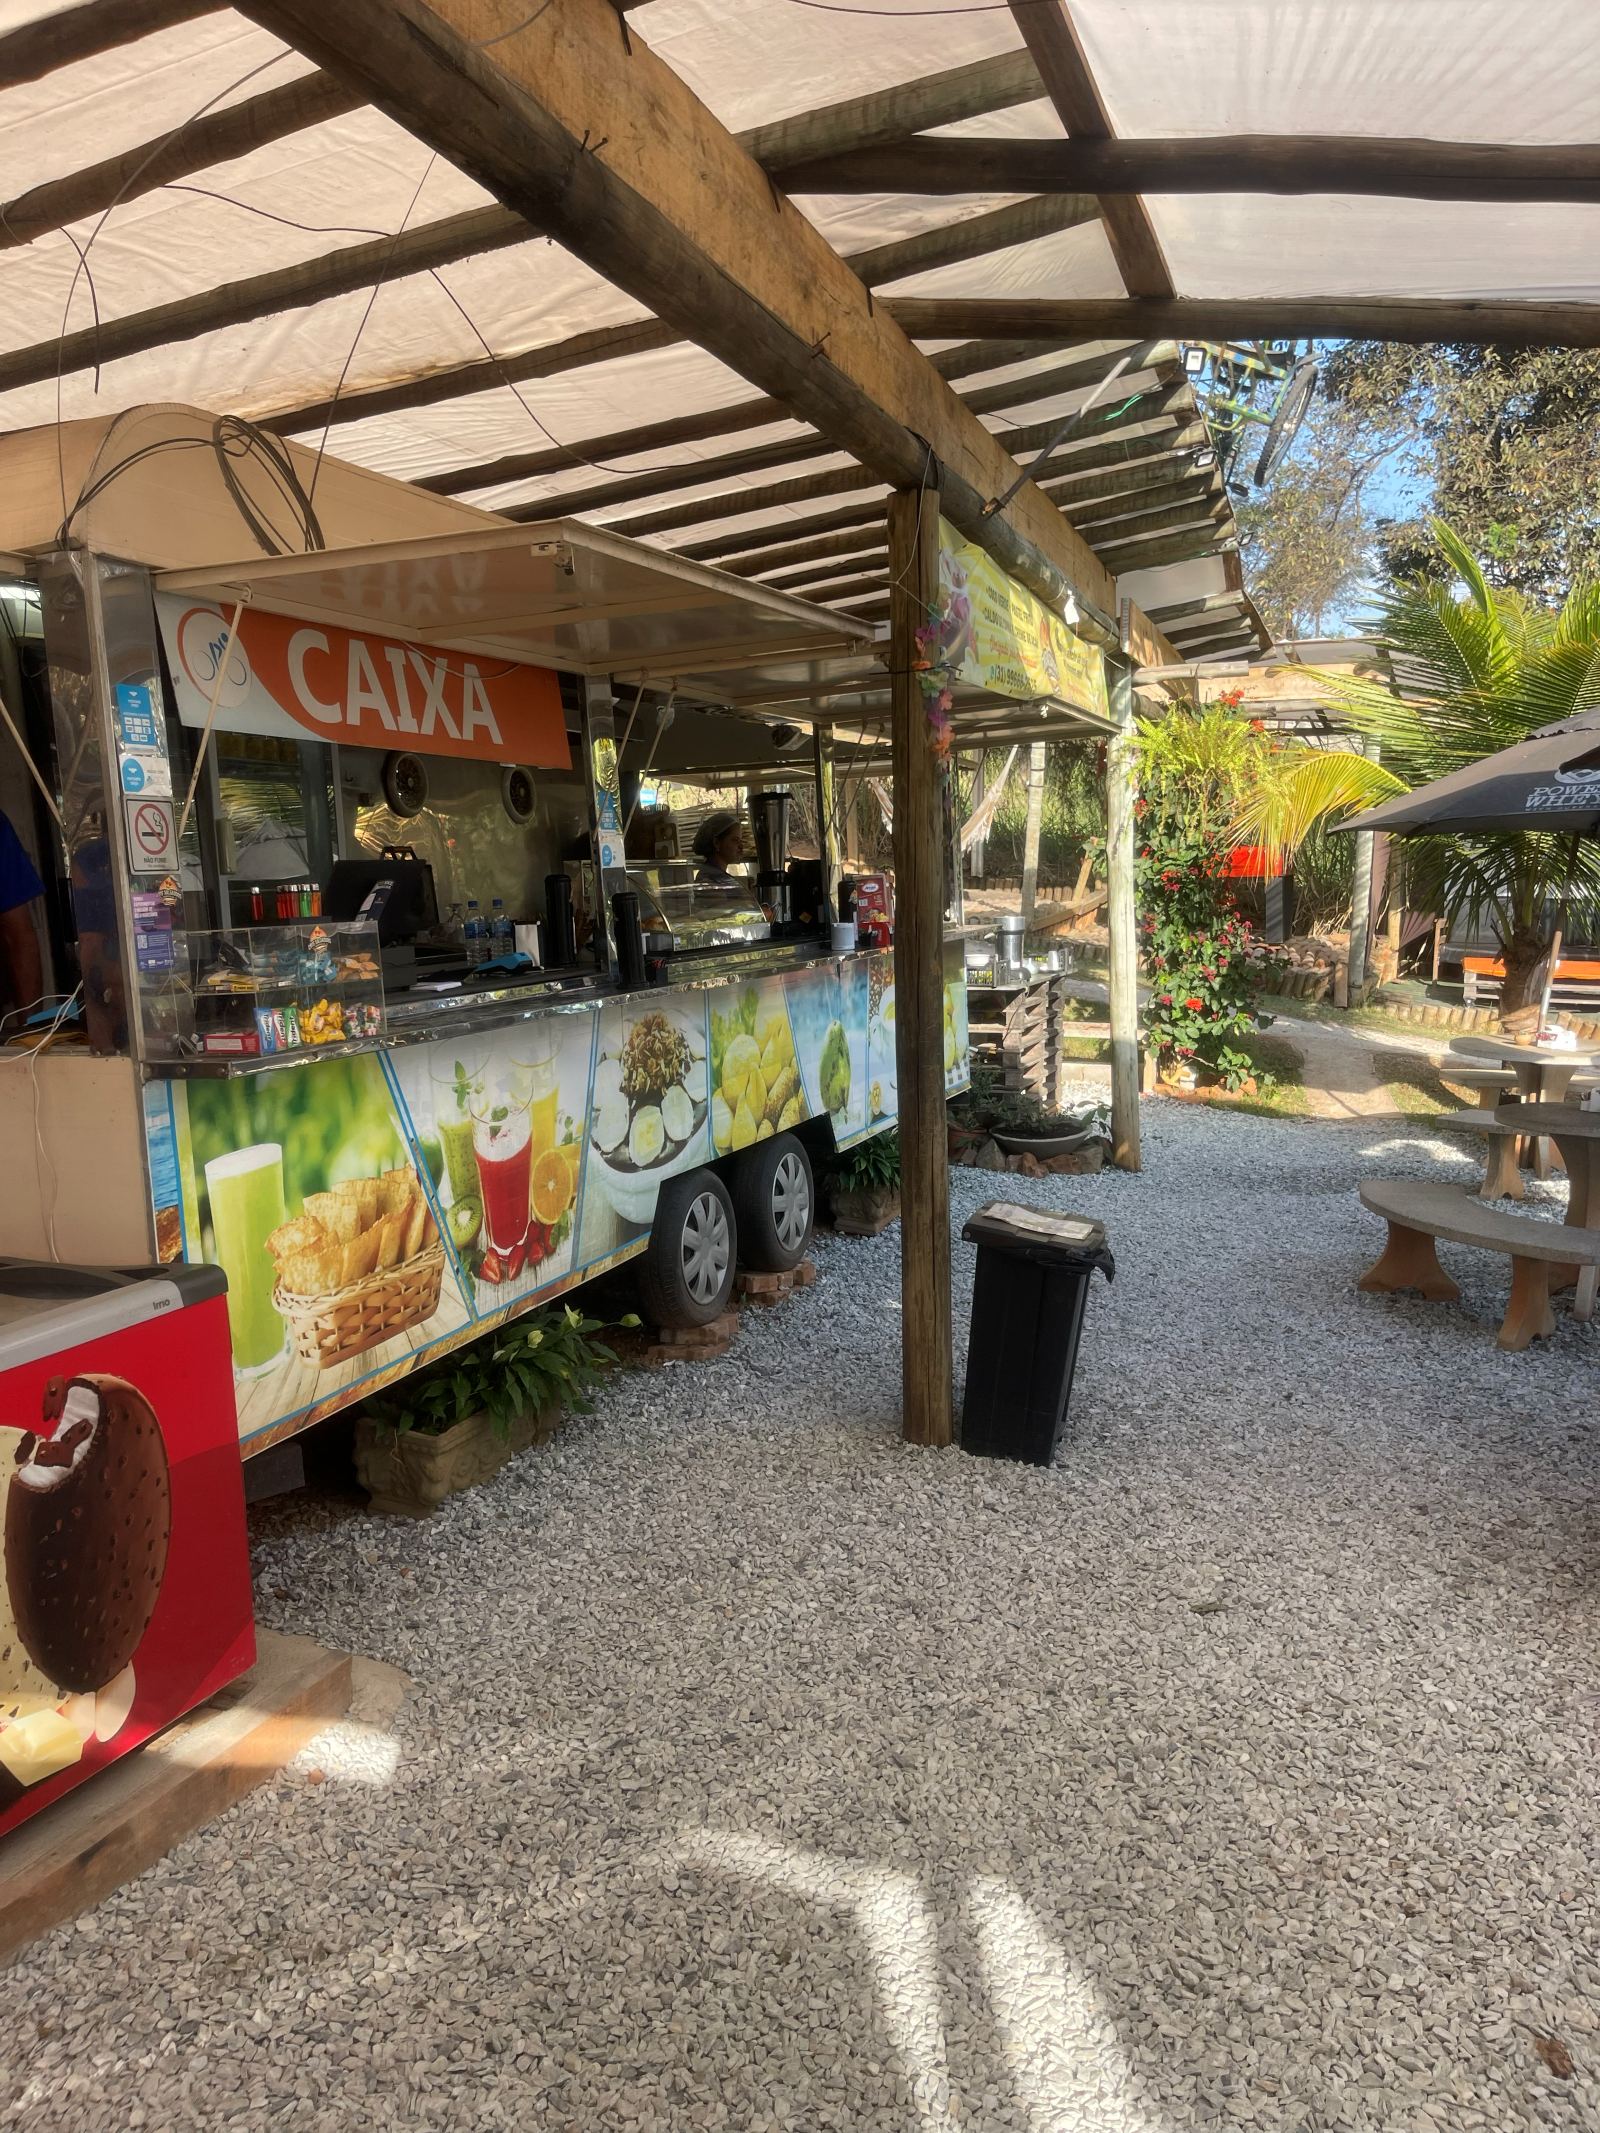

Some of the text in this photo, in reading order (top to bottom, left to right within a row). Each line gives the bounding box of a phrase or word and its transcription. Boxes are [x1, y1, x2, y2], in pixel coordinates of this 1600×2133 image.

[288, 628, 503, 744] CAIXA
[1529, 785, 1600, 797] POWE
[263, 1013, 272, 1041] Trident
[289, 1015, 298, 1046] Trident
